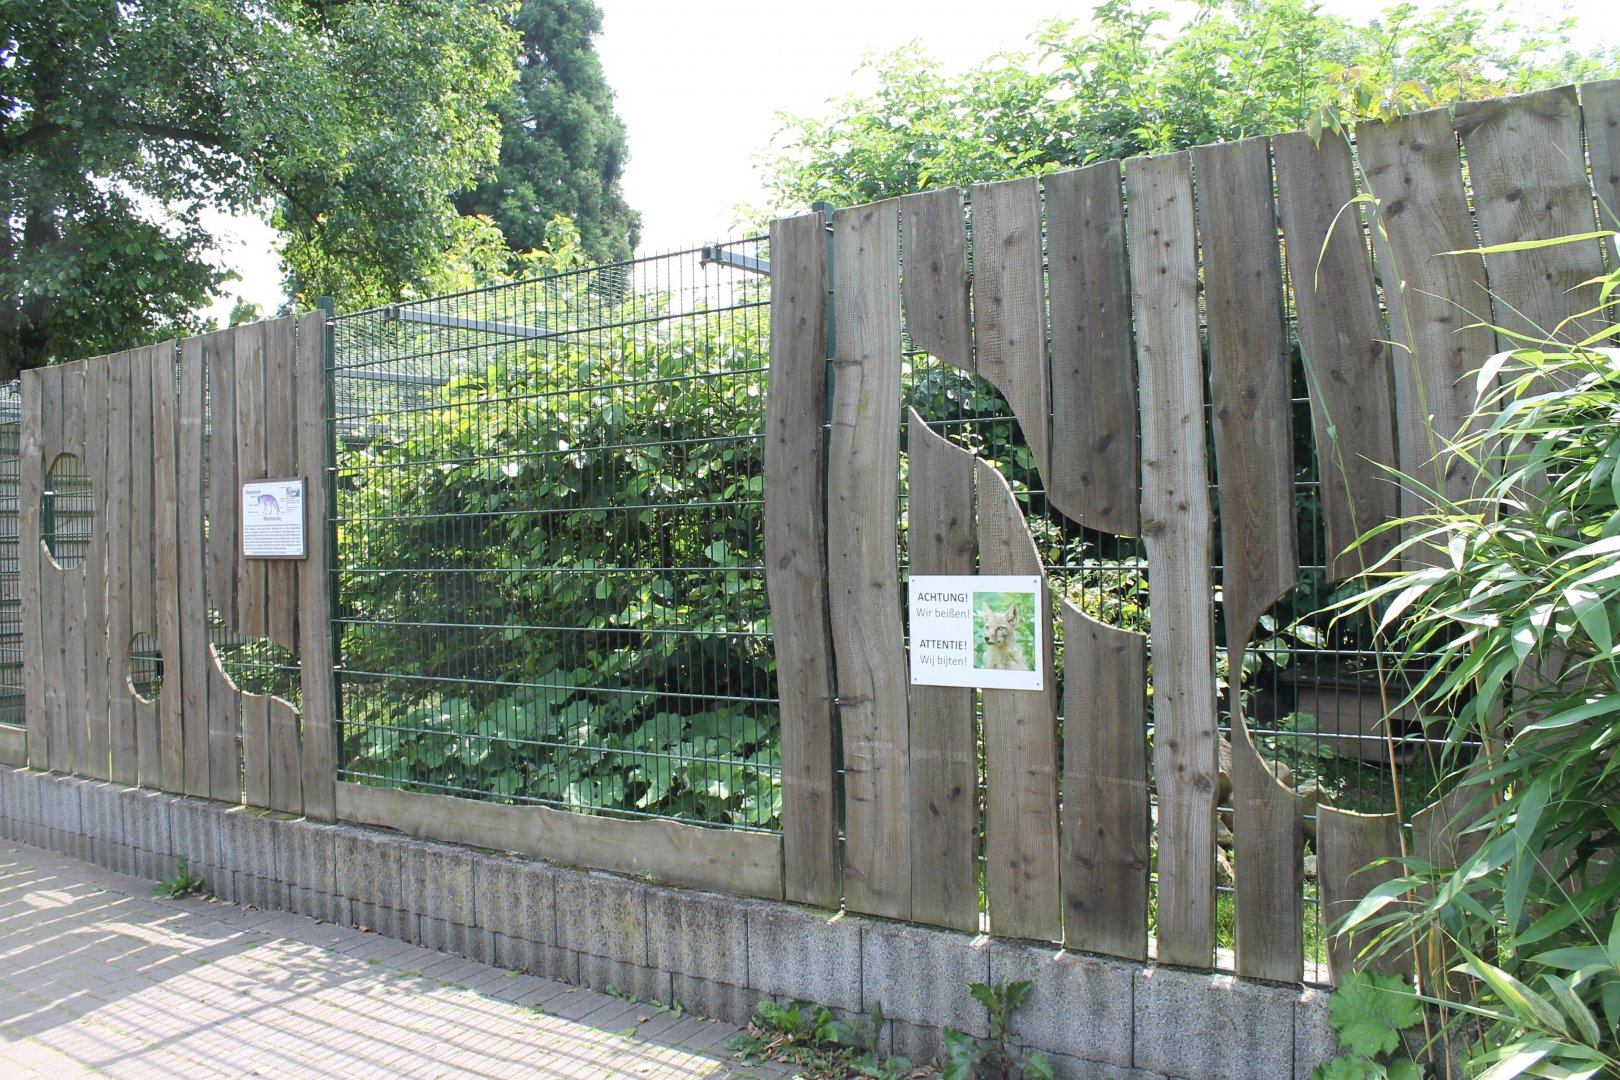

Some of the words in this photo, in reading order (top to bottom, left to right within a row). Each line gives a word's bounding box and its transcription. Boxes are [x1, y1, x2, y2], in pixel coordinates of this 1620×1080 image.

[917, 592, 968, 603] ACHTUNG!
[916, 608, 932, 617] Wir
[935, 608, 970, 619] beißen!
[919, 639, 967, 650] ATTENTIE!
[919, 654, 935, 666] Wij
[937, 655, 967, 667] bijten!
